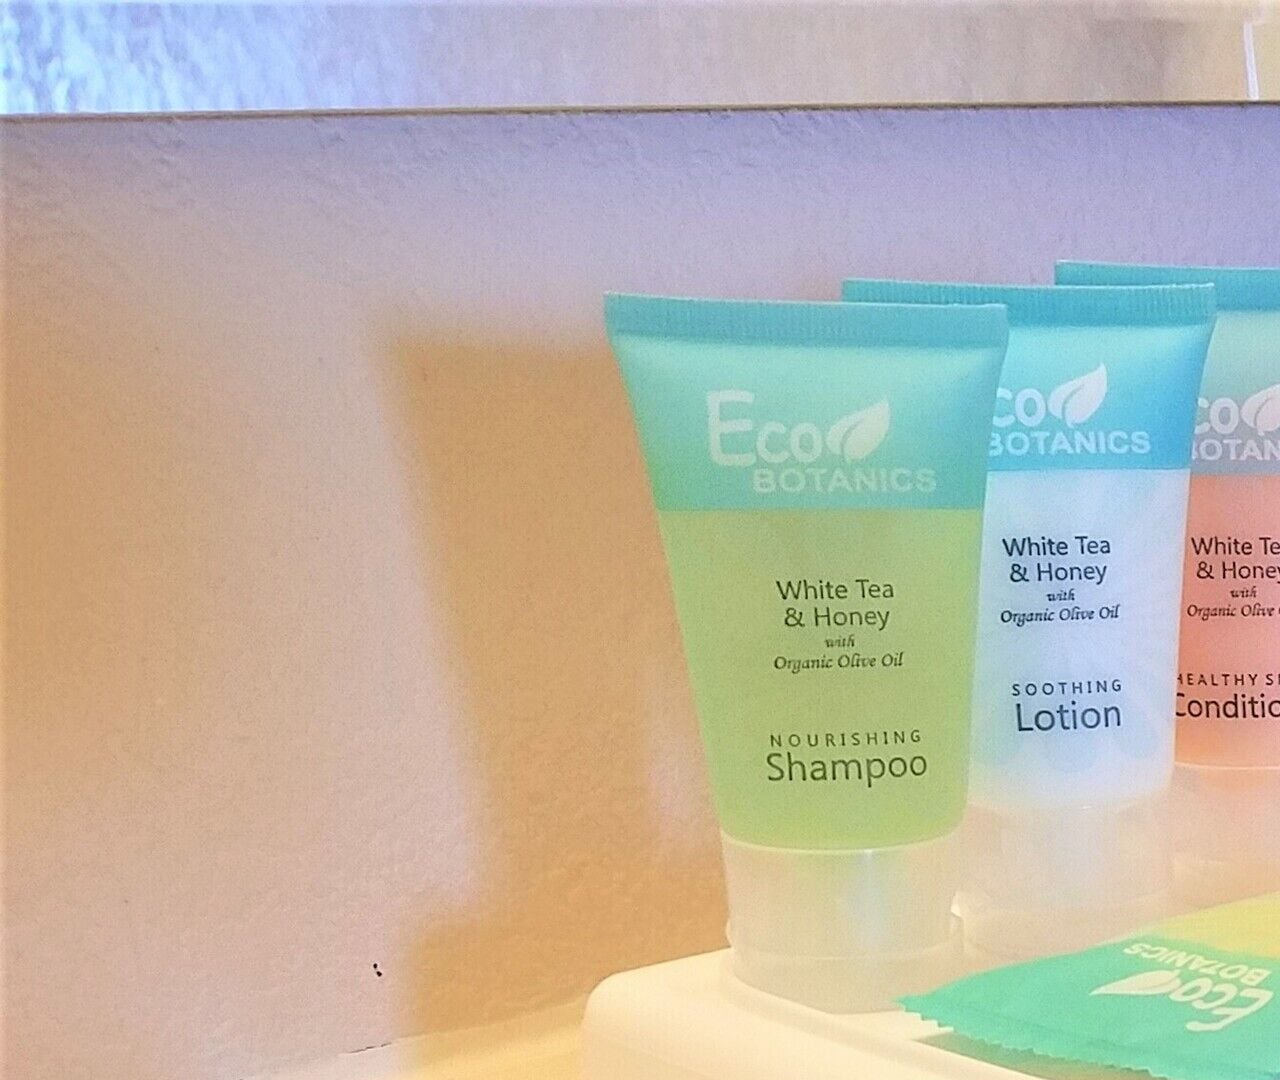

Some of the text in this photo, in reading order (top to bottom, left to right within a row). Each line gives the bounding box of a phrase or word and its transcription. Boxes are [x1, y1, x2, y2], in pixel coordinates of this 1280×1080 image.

[753, 467, 937, 493] BOTANICS
[1002, 536, 1111, 557] White Tea
[1191, 536, 1253, 555] White
[1009, 562, 1108, 585] & Honey
[1196, 561, 1215, 579] &
[776, 578, 895, 600] White Tea
[1046, 588, 1076, 601] with
[1230, 585, 1257, 598] with
[784, 606, 890, 631] & Honey
[1000, 604, 1121, 627] Organic Olive Oil
[1187, 604, 1236, 621] Organic
[1241, 604, 1275, 617] Olive
[824, 634, 856, 648] with
[774, 651, 904, 674] Organic Olive Oil
[1012, 679, 1122, 696] SOOTHING
[1015, 700, 1121, 732] Lotion
[770, 729, 921, 747] NOURISHING
[766, 751, 928, 788] Shampoo
[1122, 942, 1273, 987] BOTANICS
